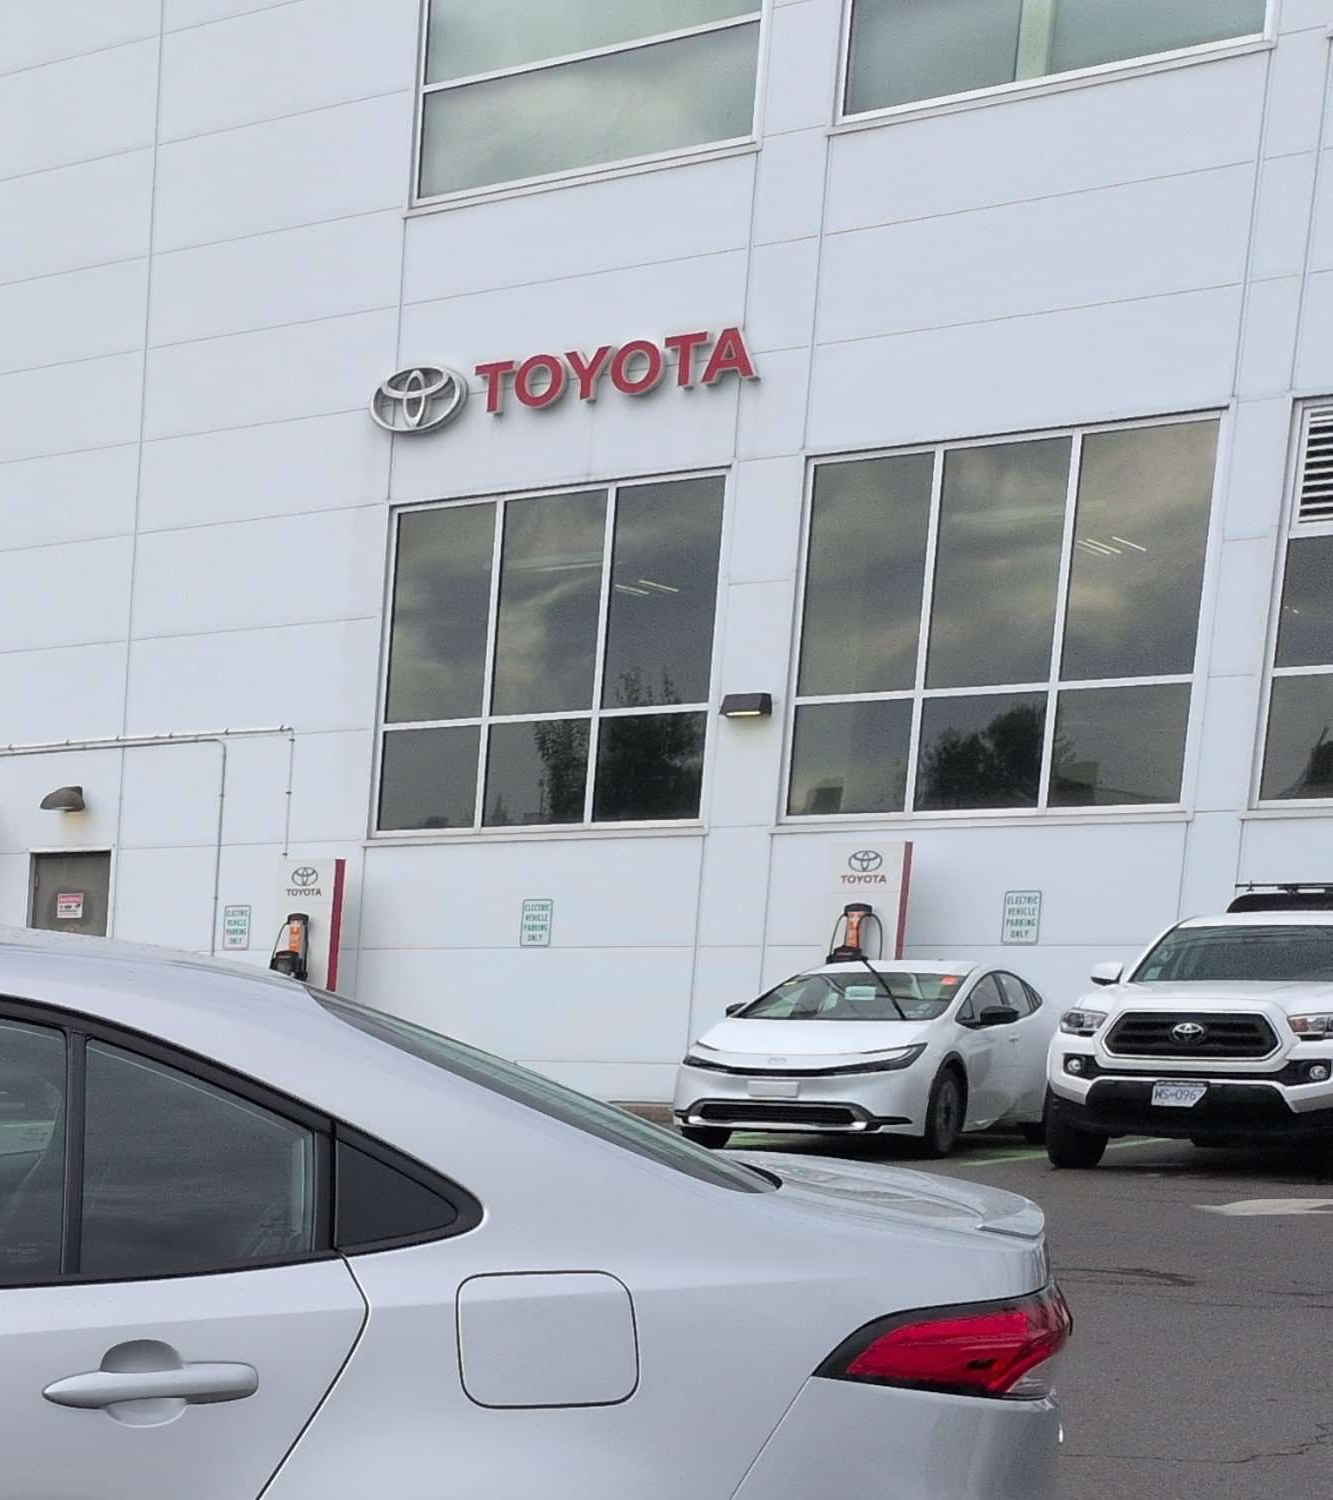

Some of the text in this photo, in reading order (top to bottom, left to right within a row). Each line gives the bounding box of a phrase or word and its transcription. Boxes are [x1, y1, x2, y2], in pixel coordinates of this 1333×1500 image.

[475, 327, 758, 415] TOYOTA
[841, 874, 887, 884] TOYOTA
[286, 888, 322, 896] TOYOTA
[1006, 918, 1036, 927] PARKING
